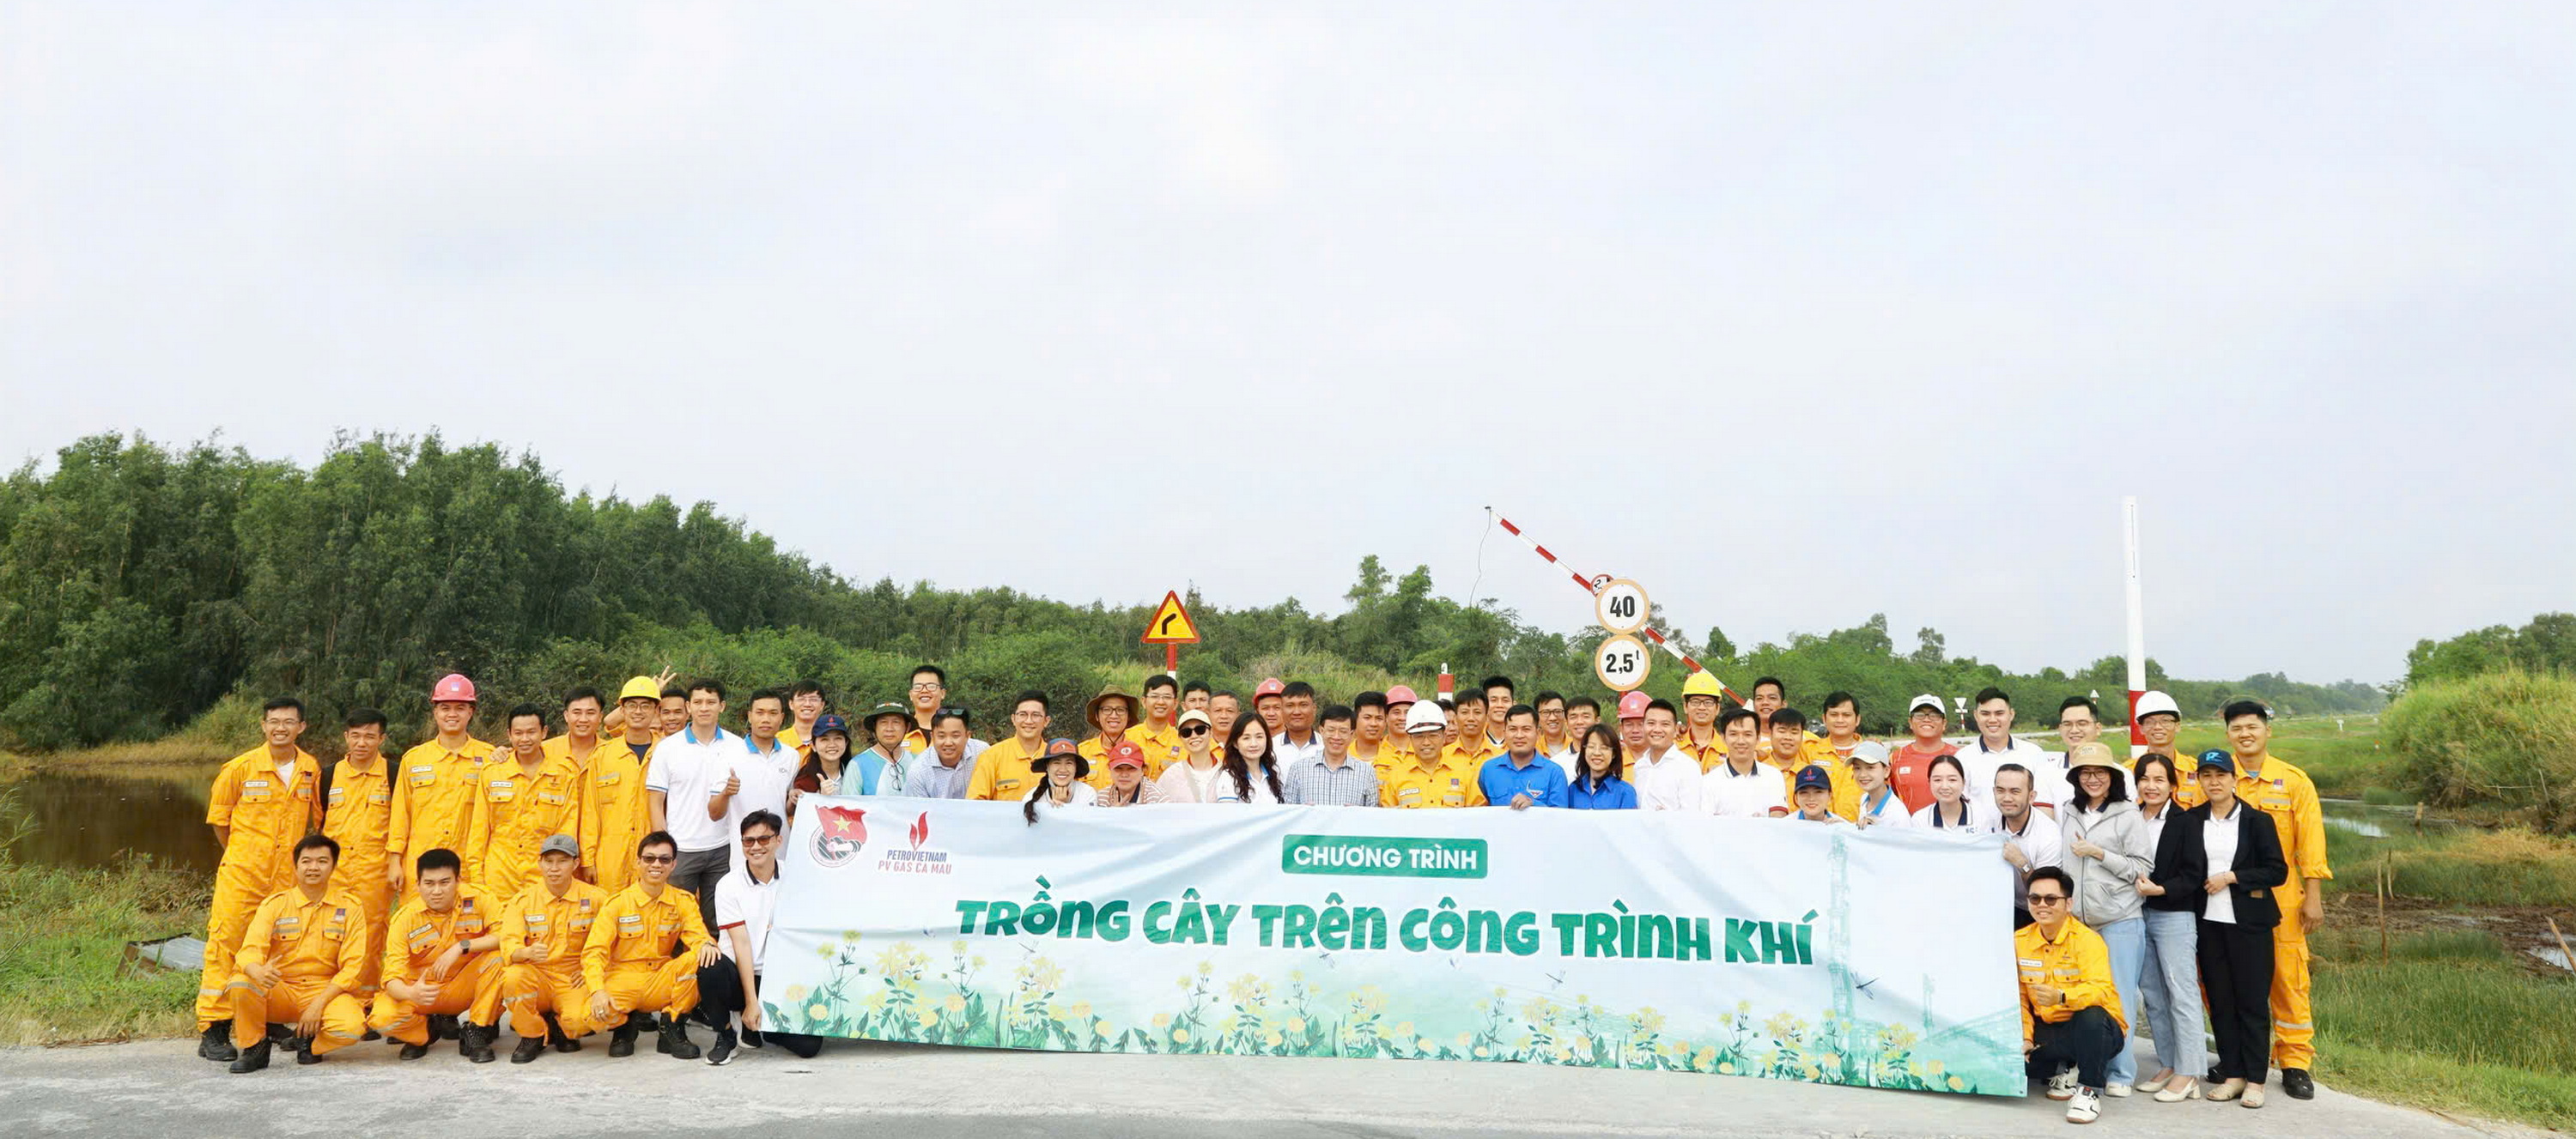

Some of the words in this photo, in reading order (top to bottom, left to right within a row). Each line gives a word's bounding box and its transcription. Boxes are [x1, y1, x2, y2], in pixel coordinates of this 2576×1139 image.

[1609, 596, 1635, 617] 40
[878, 860, 891, 870] PV
[893, 861, 913, 872] GAS
[887, 850, 947, 862] PETROVIETNAM
[1293, 844, 1402, 869] CHƯƠNG
[1408, 843, 1478, 870] TRÌNH
[1142, 888, 1242, 946] CÂY
[1725, 909, 1819, 965] KHÍ
